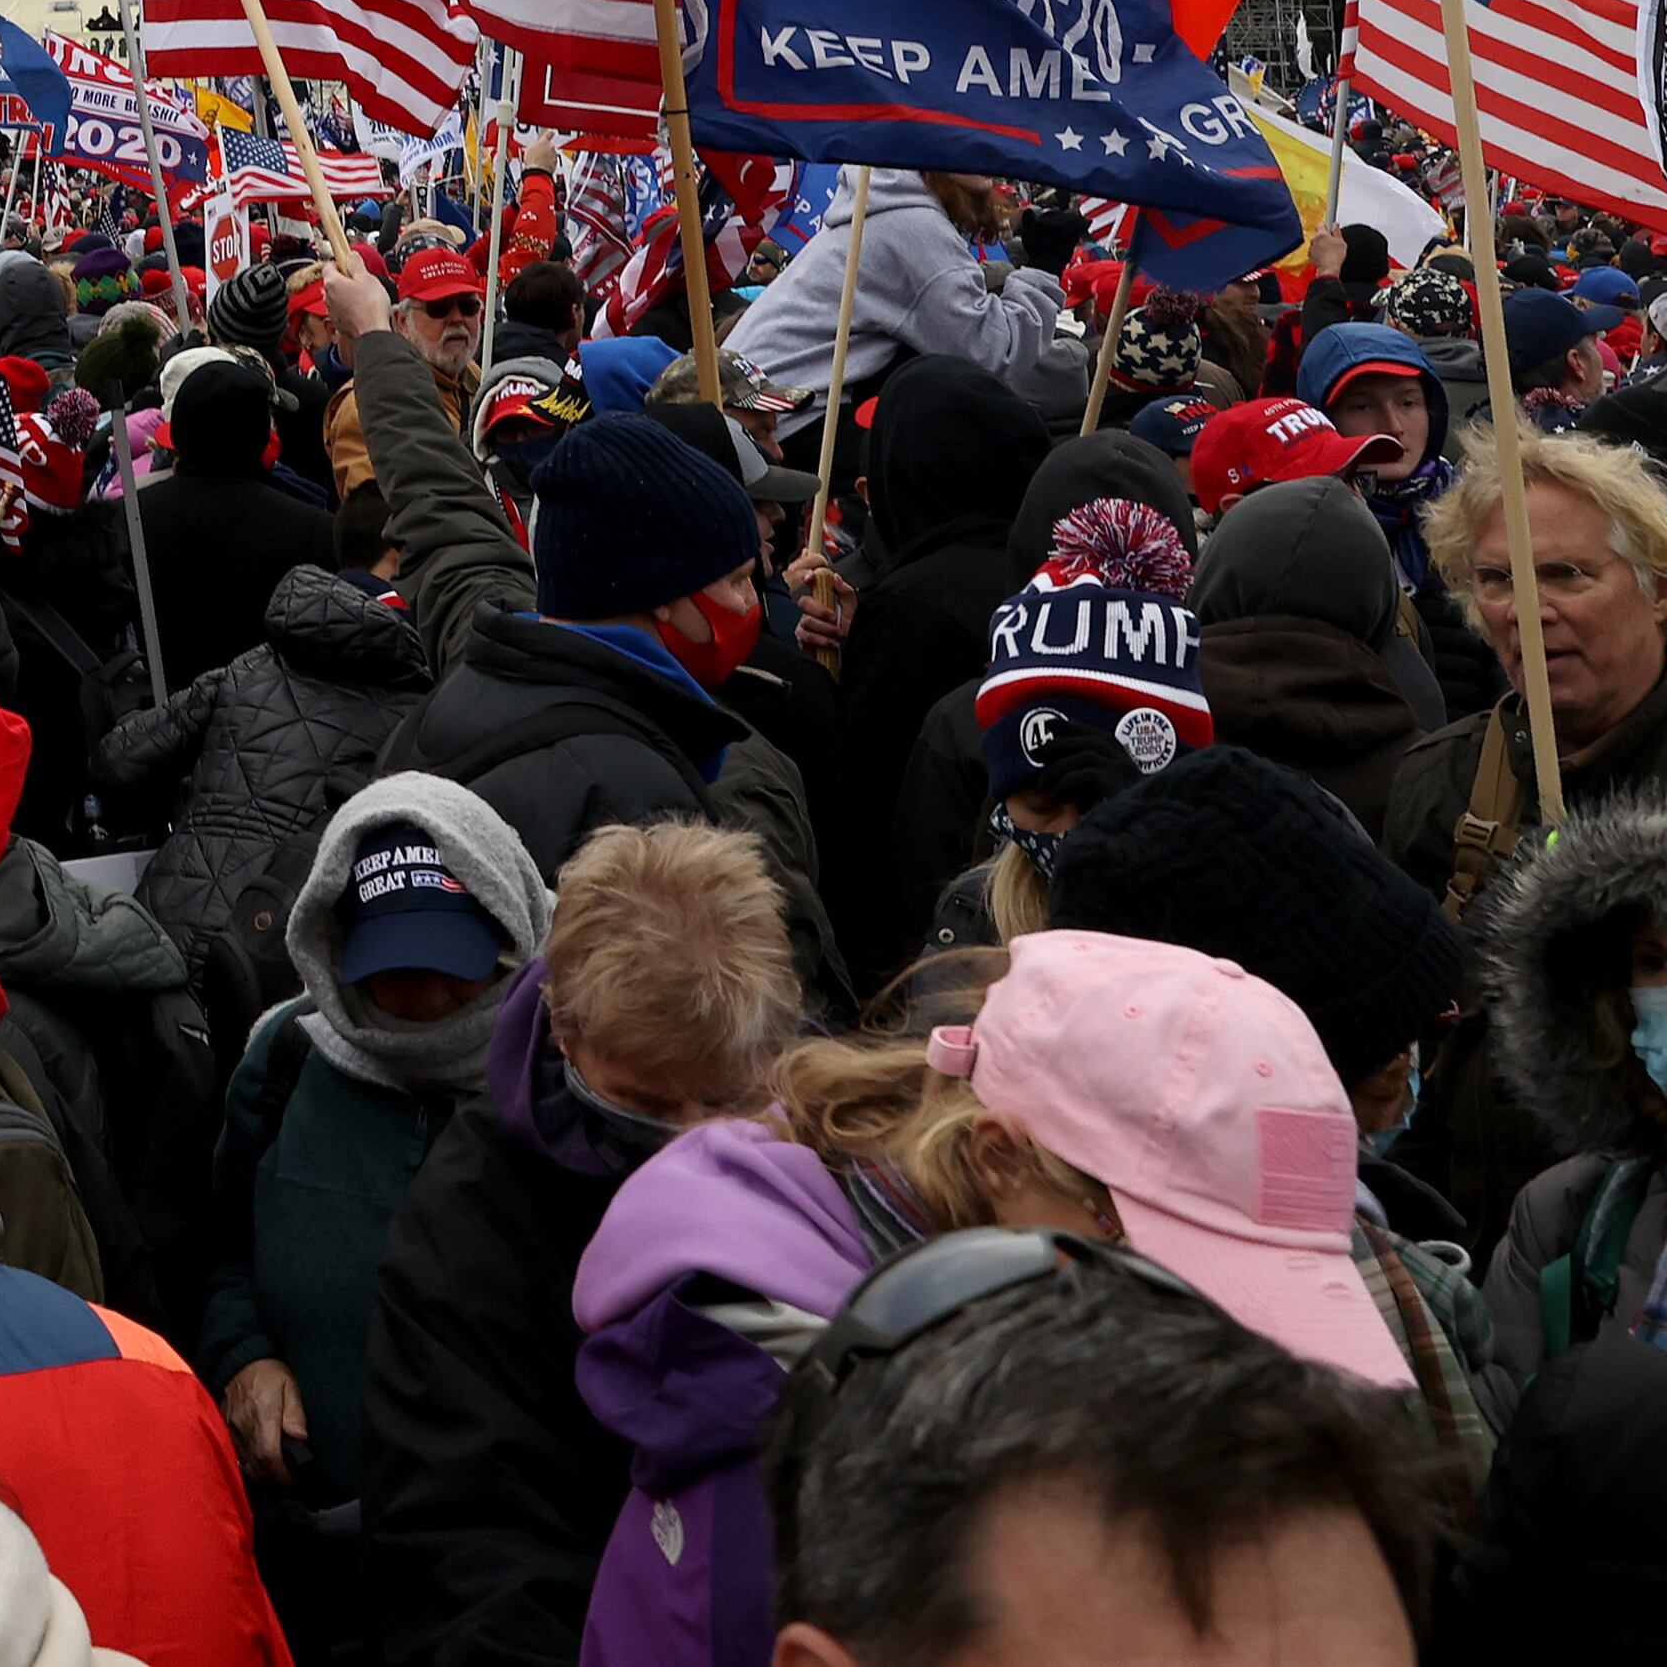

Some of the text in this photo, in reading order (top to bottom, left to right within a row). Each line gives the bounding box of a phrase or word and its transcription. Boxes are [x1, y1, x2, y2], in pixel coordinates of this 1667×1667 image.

[760, 24, 932, 86] KEEP
[82, 90, 182, 125] MORE BUSHIT
[64, 116, 184, 170] 2020
[1174, 401, 1218, 423] TRU
[1266, 407, 1337, 445] TRUM
[989, 598, 1201, 670] RUMP
[1130, 734, 1165, 747] TRUMP
[353, 849, 392, 882] KEEP
[358, 870, 406, 903] GREAT
